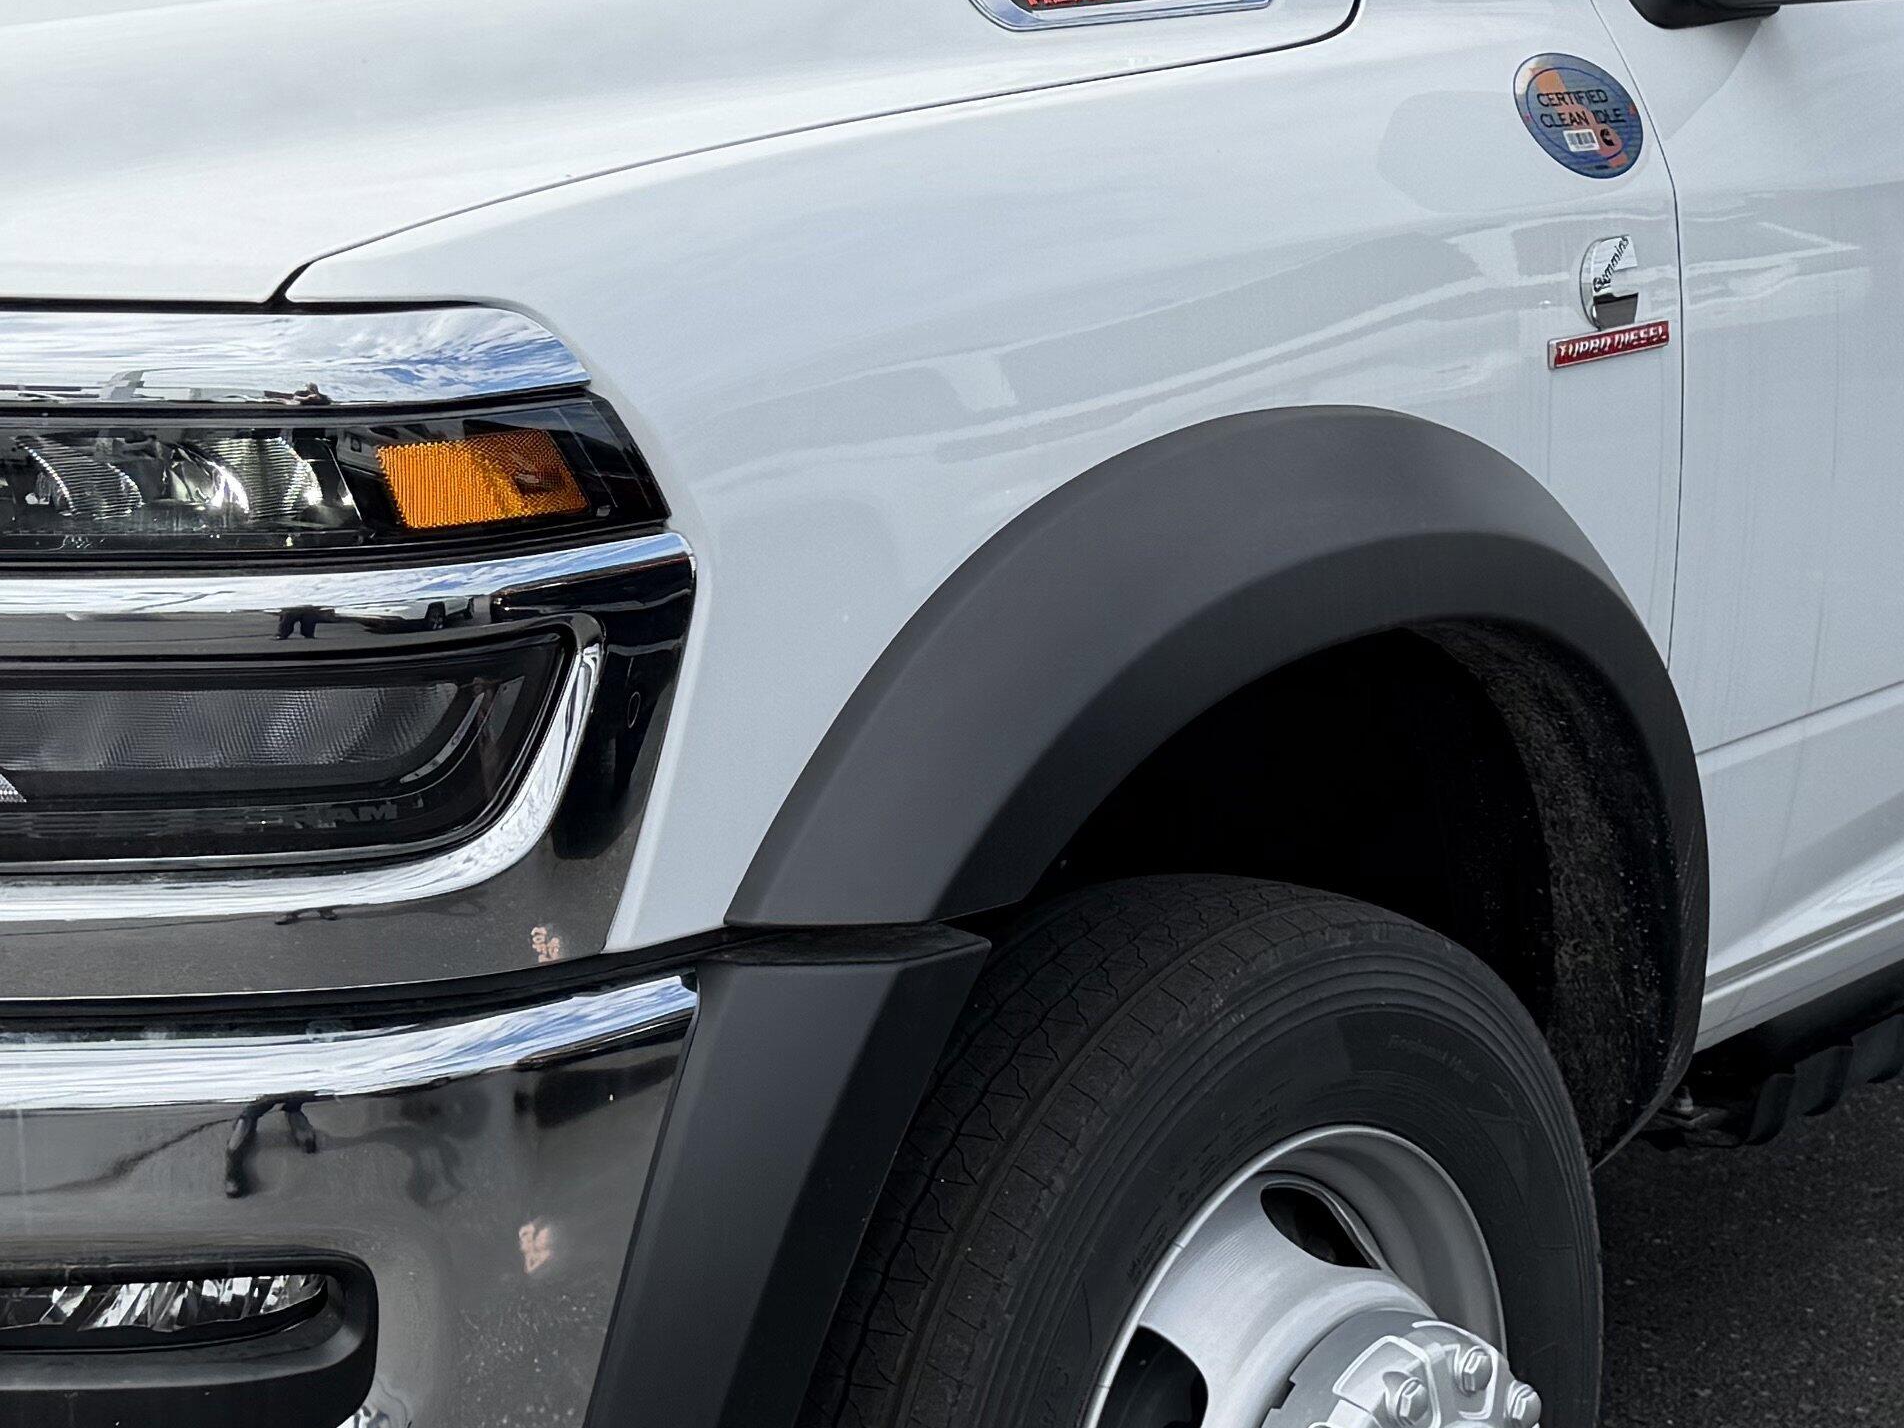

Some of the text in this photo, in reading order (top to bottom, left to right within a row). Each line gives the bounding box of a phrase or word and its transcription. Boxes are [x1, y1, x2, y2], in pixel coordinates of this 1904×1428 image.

[1536, 88, 1609, 107] CERTIFIED
[1540, 107, 1627, 128] CLEAN IDLE
[1592, 235, 1630, 293] Cummins
[1614, 325, 1667, 349] DIESEL
